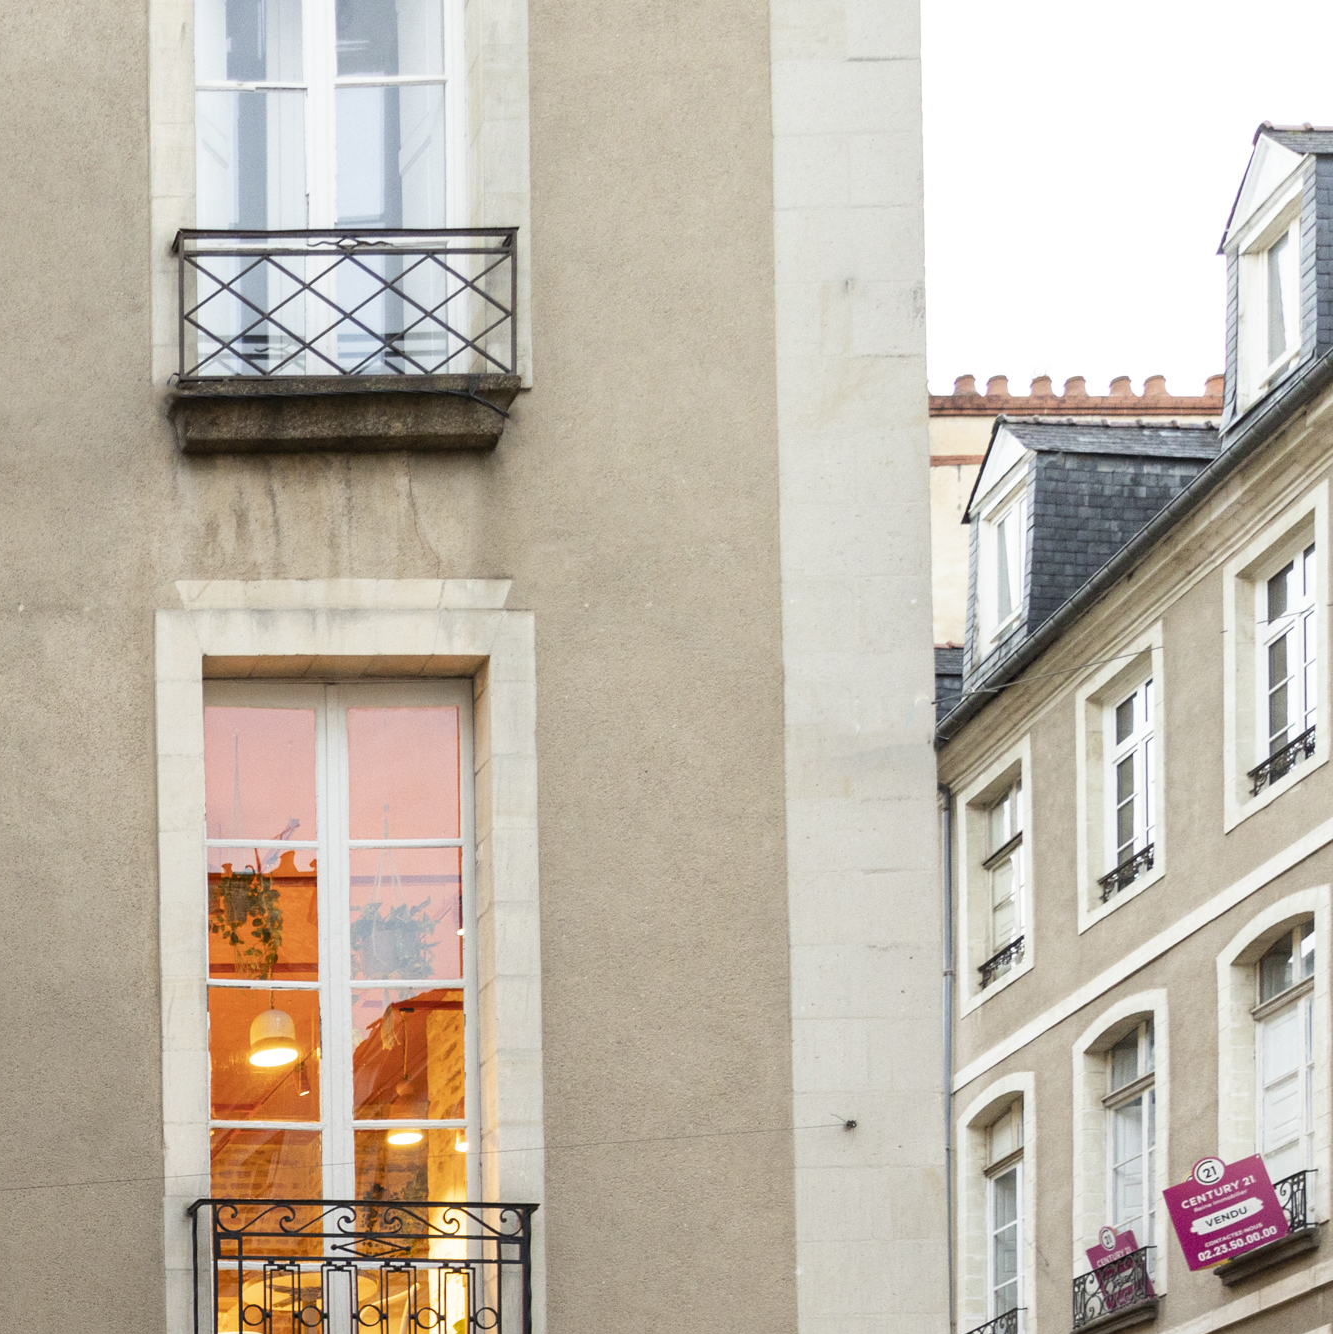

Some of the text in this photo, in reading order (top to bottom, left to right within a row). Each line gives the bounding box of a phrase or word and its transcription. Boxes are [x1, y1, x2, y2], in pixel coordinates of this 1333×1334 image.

[1203, 1166, 1217, 1179] 21
[1181, 1175, 1256, 1209] CENTURY 21
[1213, 1189, 1248, 1205] Immobilier
[1205, 1206, 1248, 1227] VENDU
[1197, 1225, 1278, 1262] 02.23.50.00.00
[1204, 1222, 1264, 1248] CONTACTEZ-NOUS
